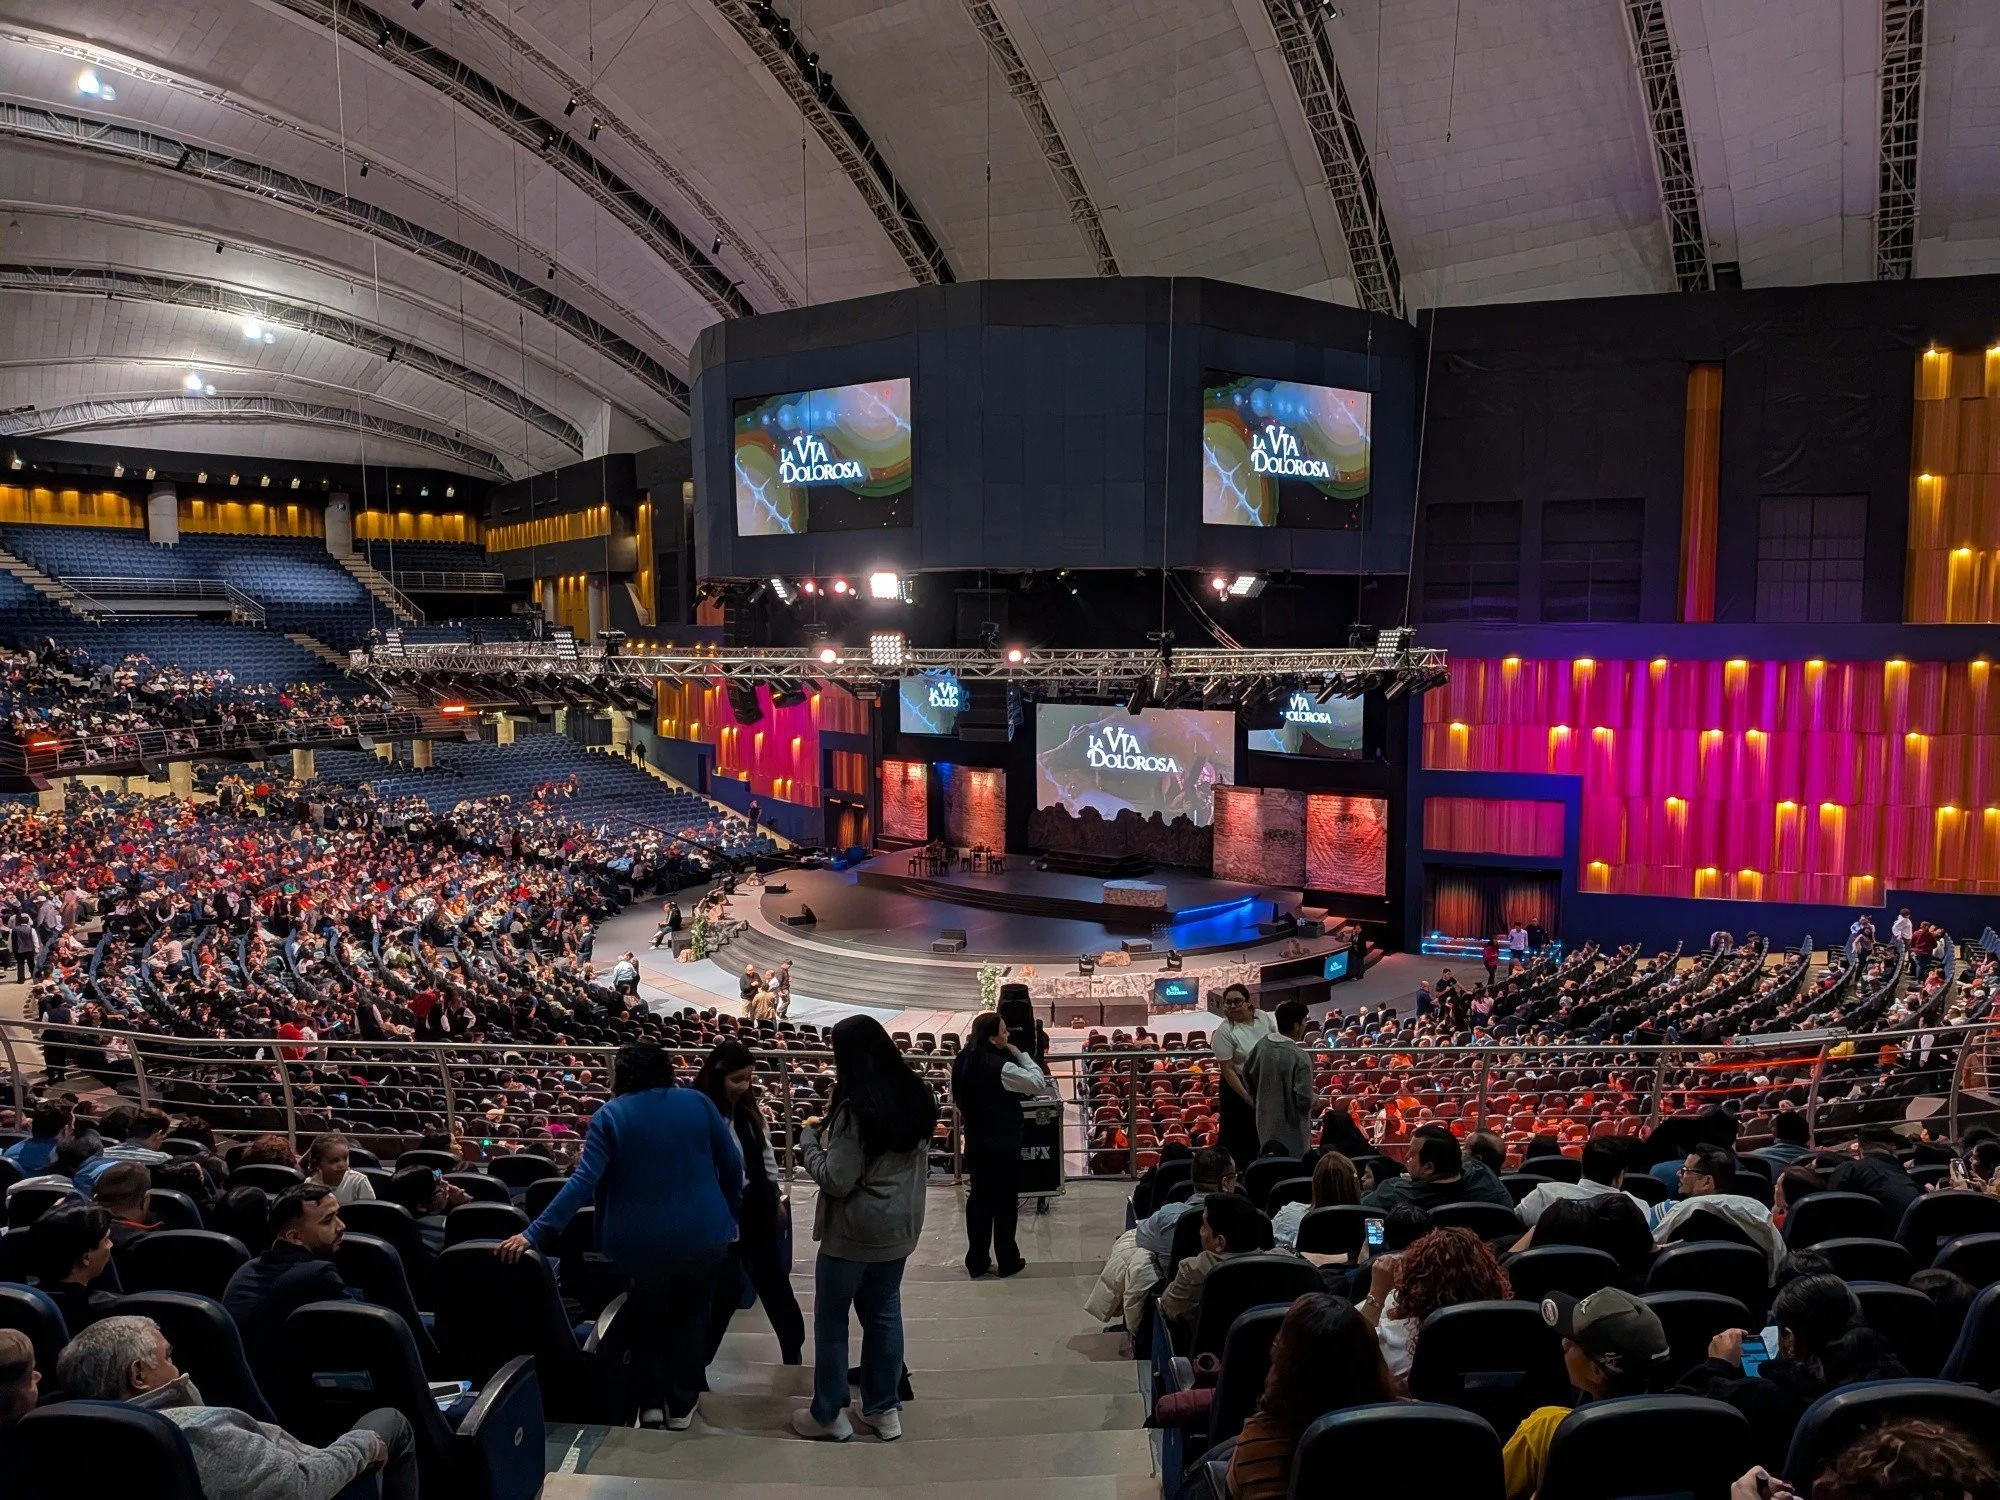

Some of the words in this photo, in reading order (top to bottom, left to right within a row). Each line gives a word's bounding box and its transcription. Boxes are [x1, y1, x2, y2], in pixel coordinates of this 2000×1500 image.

[780, 448, 794, 463] LA
[793, 434, 829, 468] VIA
[1252, 434, 1267, 450] LA
[1265, 424, 1299, 459] VIA
[779, 461, 862, 484] DOLOROSA
[1250, 450, 1330, 478] DOLOROSA
[1088, 734, 1104, 749] LA
[1102, 726, 1142, 758] VIA
[1086, 747, 1179, 773] DOLOROSA
